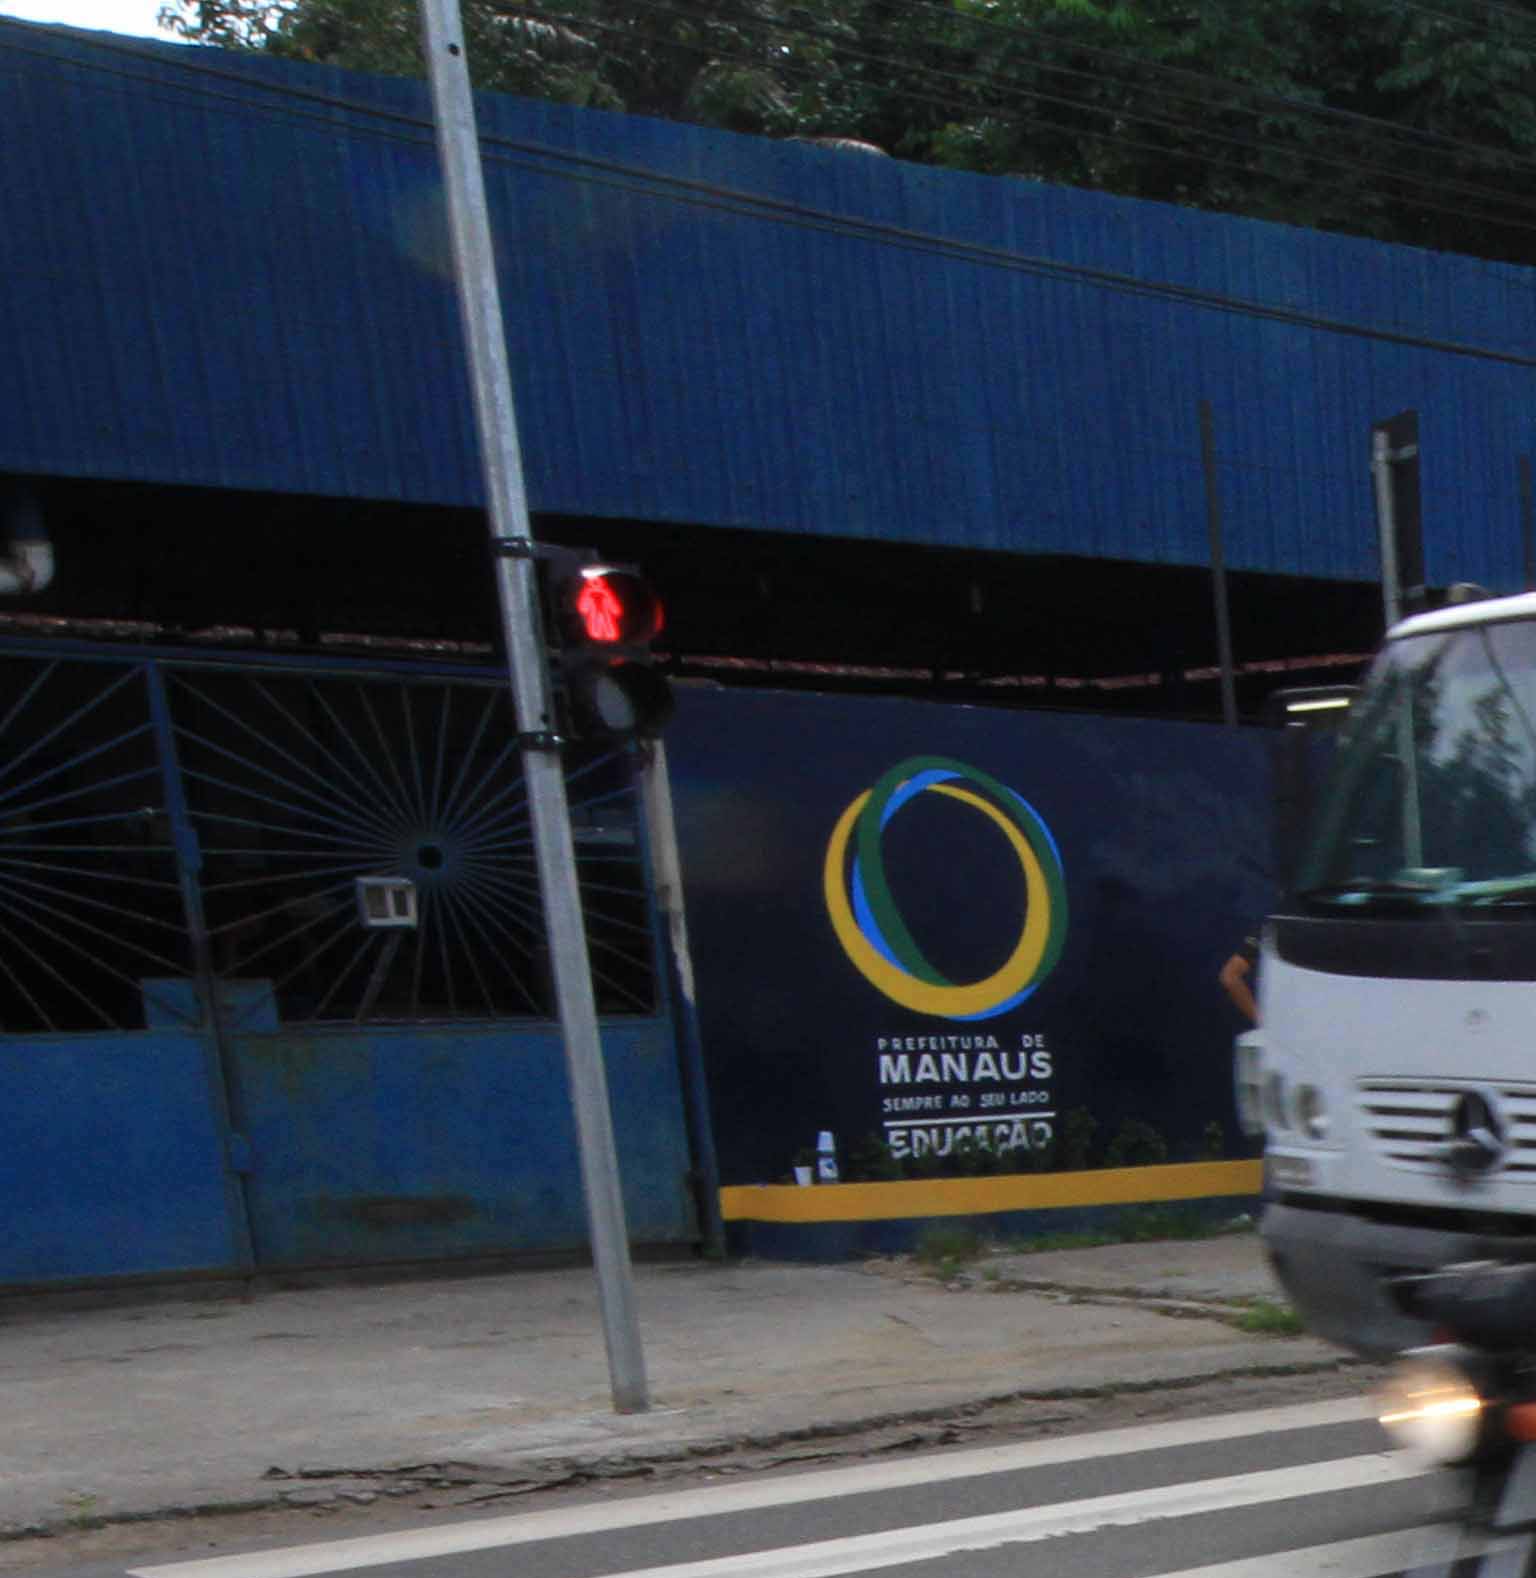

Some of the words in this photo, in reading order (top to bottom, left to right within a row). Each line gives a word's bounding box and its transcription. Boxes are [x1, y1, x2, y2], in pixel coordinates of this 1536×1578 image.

[877, 1035, 1000, 1051] PREFEITURA
[1021, 1033, 1045, 1049] DE
[879, 1051, 1054, 1084] MANAUS
[882, 1095, 943, 1113] SEMPRE
[950, 1093, 970, 1108] AO
[1010, 1090, 1049, 1105] LADO
